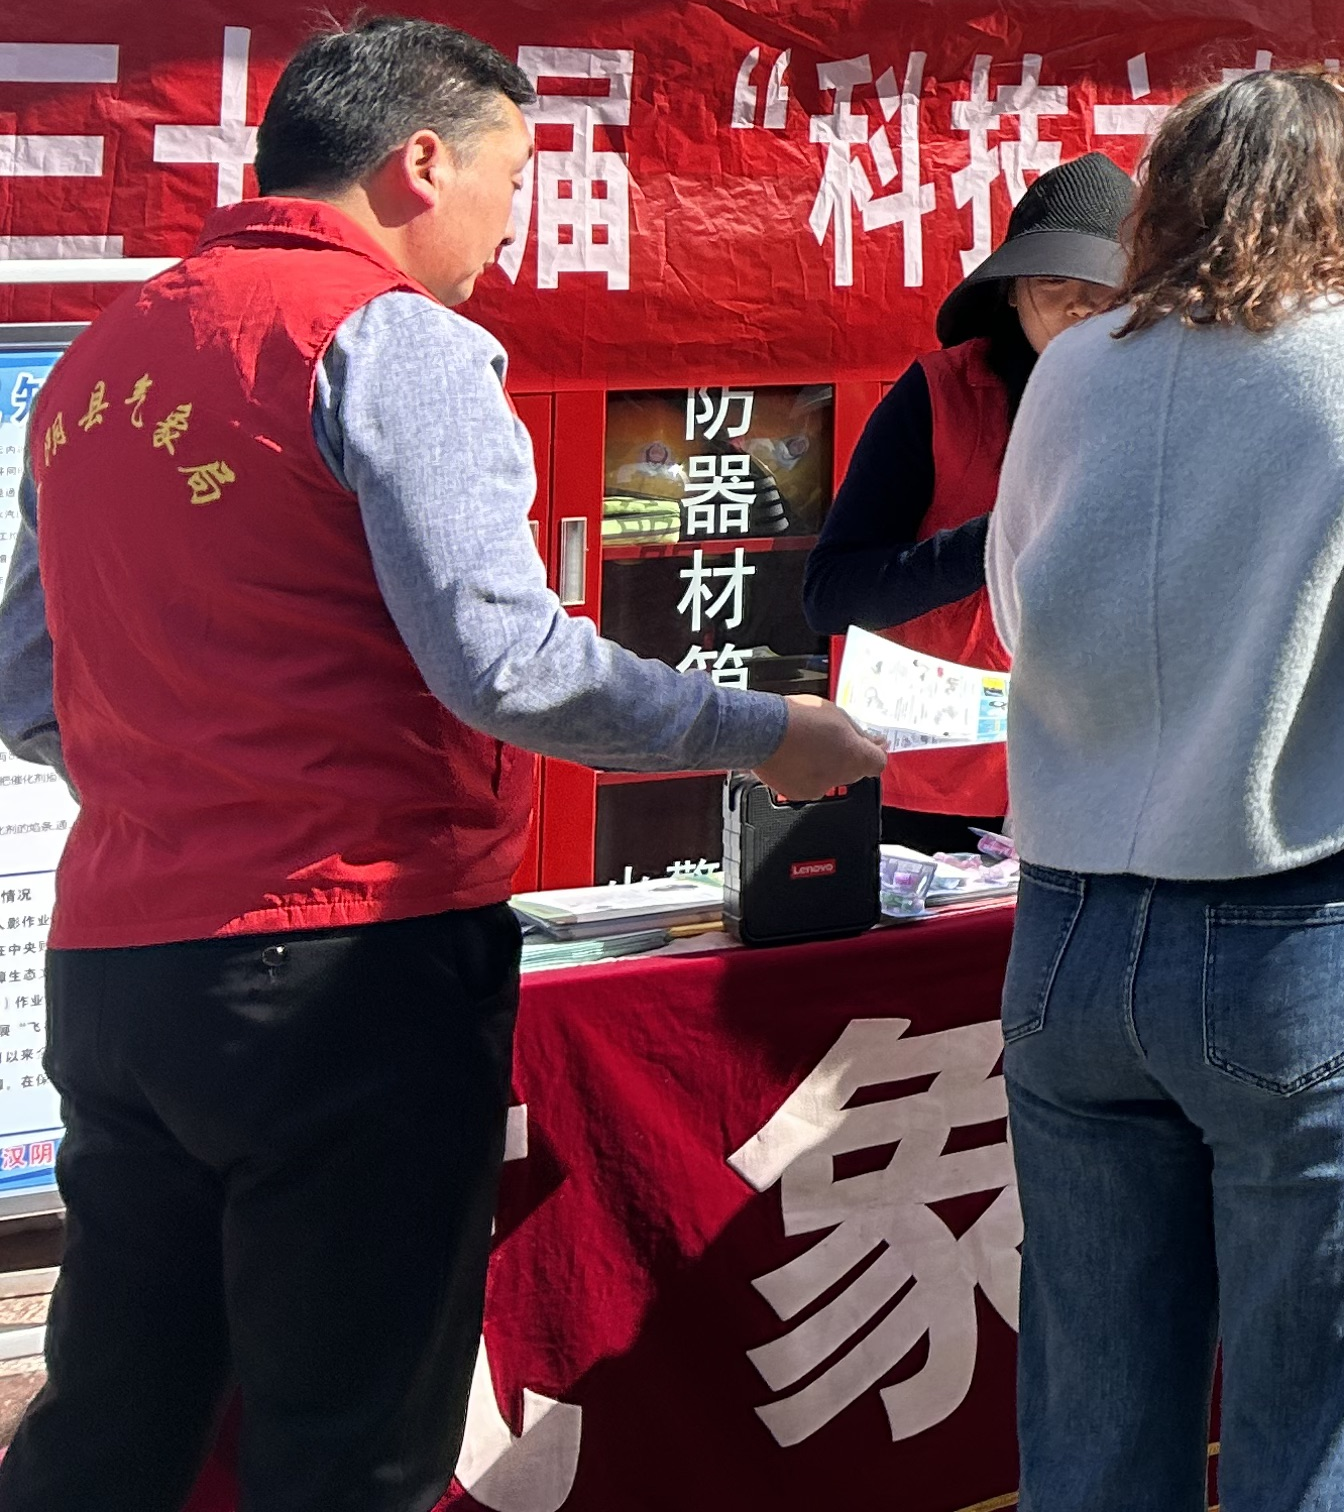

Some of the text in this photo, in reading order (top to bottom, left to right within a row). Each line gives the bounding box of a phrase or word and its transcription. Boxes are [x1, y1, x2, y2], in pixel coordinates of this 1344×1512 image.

[792, 861, 835, 878] Lenovo
[0, 914, 50, 930] 影作业
